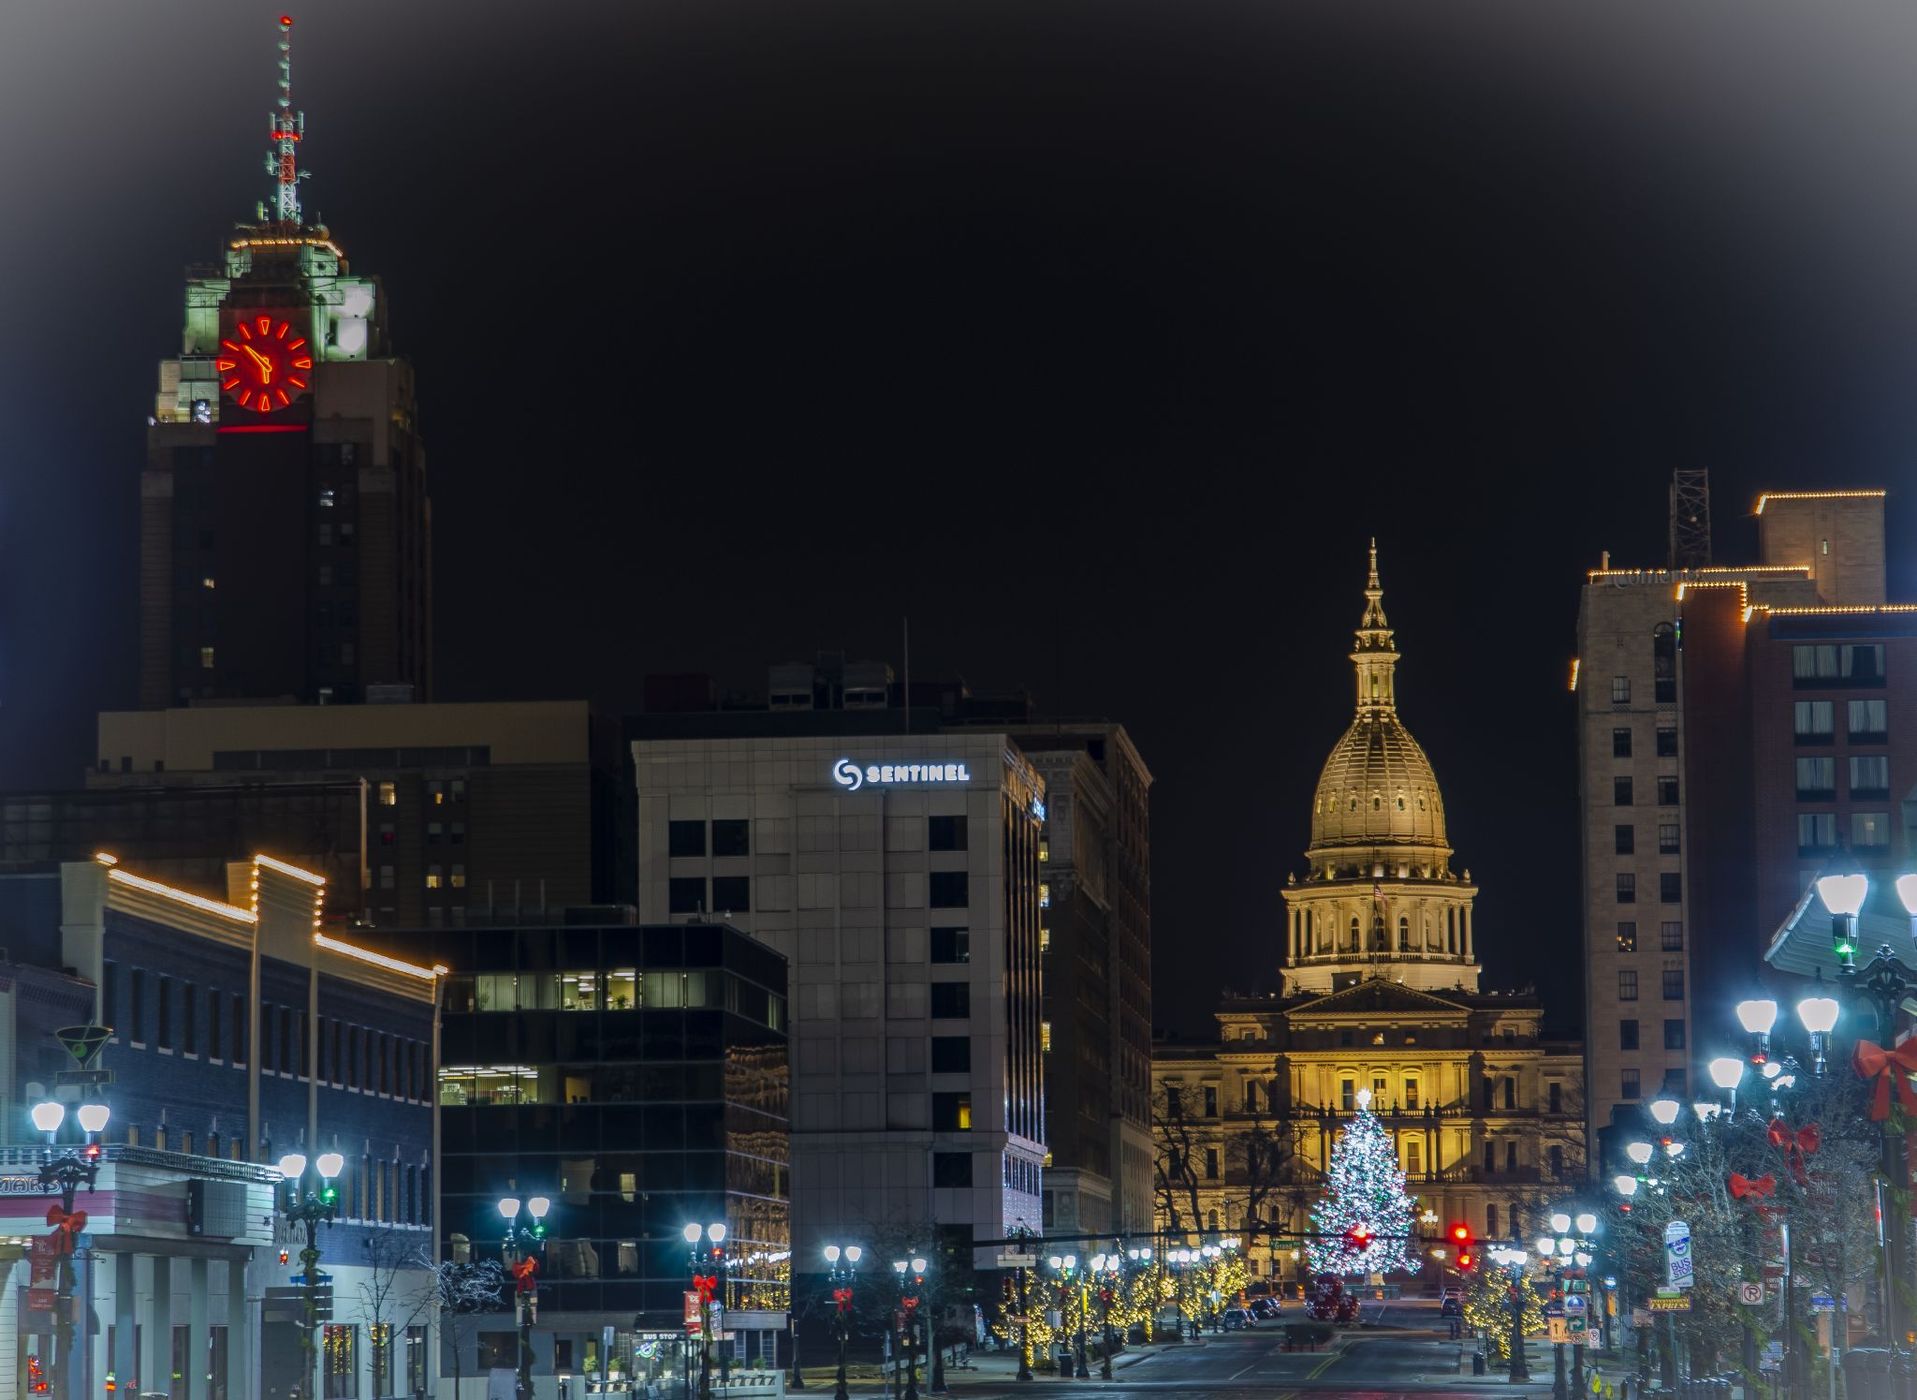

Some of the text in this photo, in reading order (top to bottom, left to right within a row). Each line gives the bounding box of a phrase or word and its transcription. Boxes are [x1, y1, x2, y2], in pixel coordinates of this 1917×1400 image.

[866, 765, 970, 783] SENTINEL
[1671, 1257, 1691, 1272] BUS
[1673, 1265, 1692, 1279] STOP
